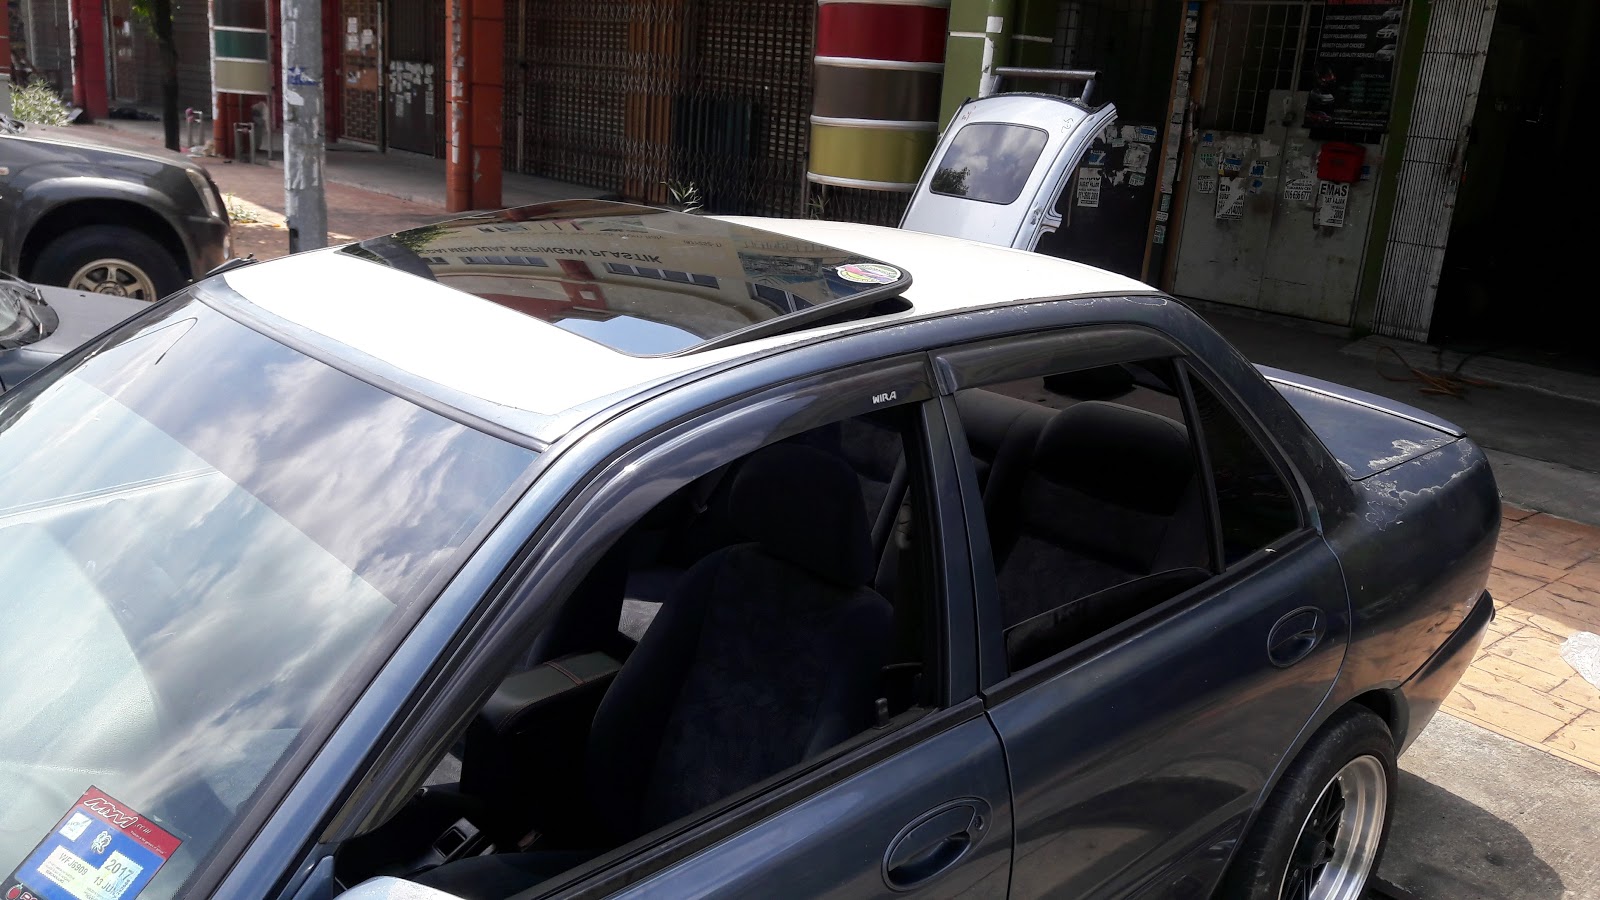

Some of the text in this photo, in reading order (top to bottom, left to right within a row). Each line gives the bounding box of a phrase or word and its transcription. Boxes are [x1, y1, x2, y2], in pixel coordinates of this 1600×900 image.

[1320, 183, 1348, 197] EMAS
[872, 390, 897, 404] WIRA
[59, 852, 89, 876] WFJ6909
[104, 858, 134, 881] 2017
[93, 875, 103, 887] 13
